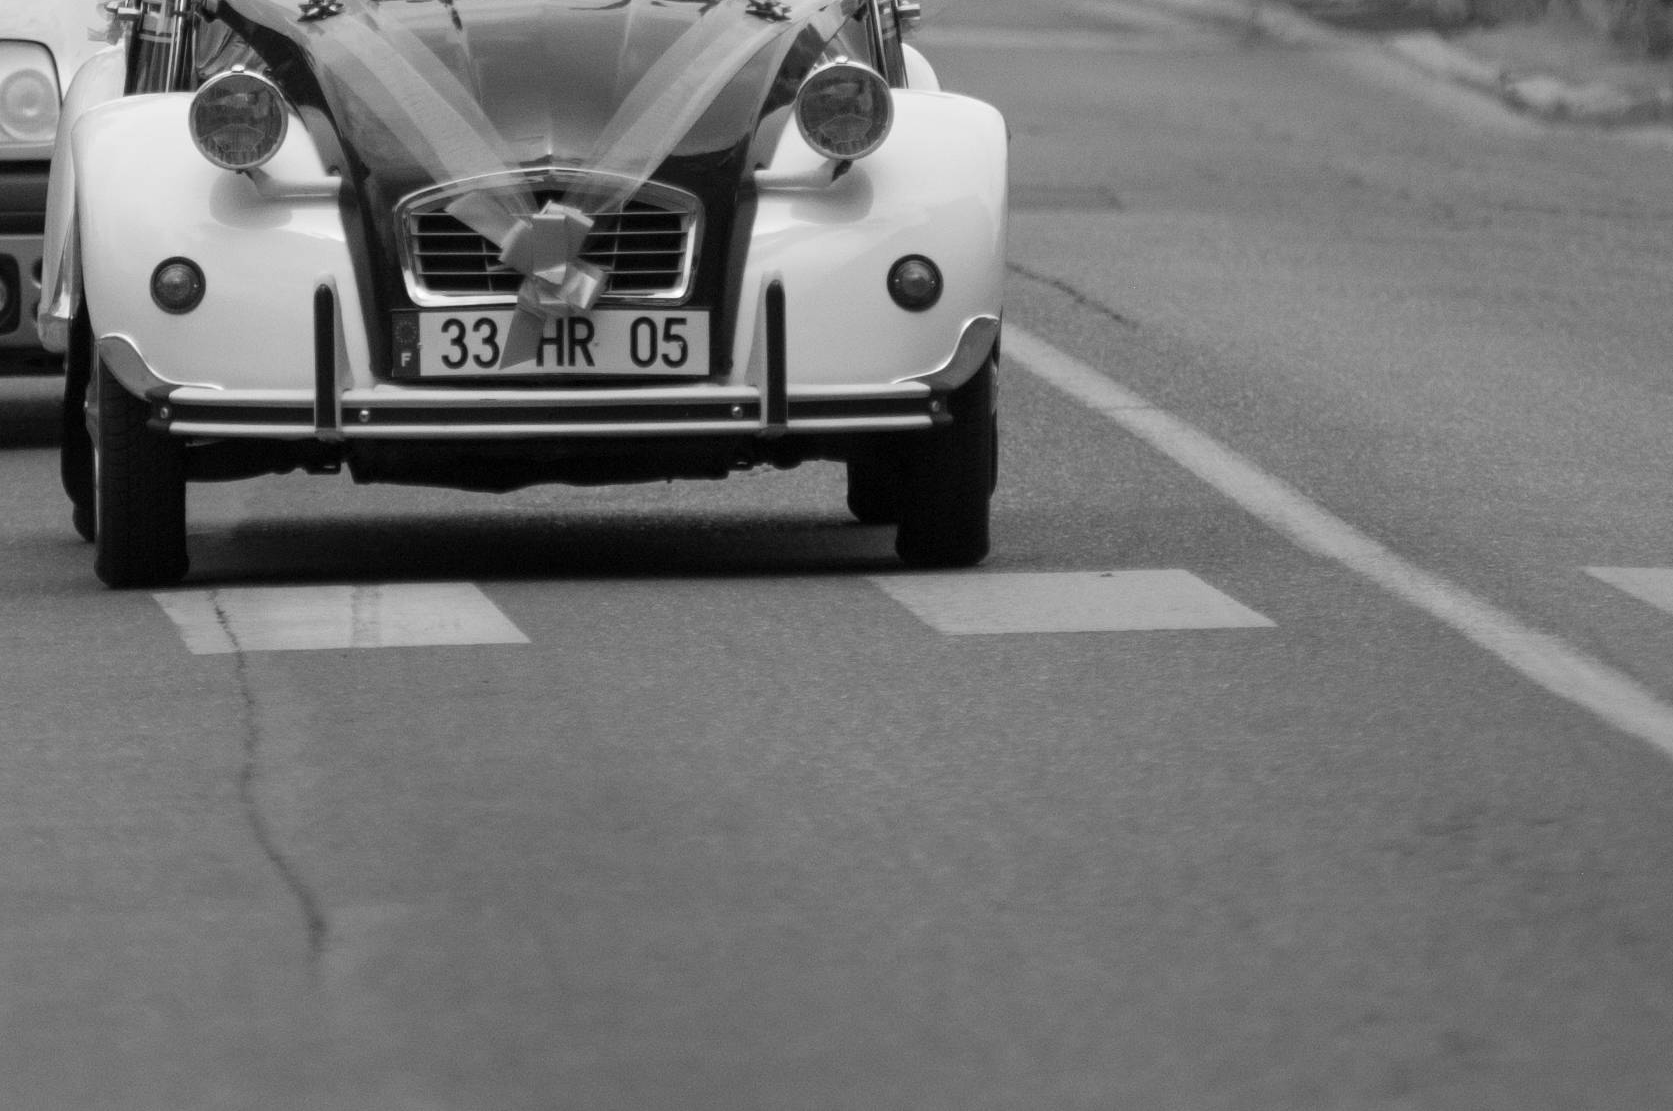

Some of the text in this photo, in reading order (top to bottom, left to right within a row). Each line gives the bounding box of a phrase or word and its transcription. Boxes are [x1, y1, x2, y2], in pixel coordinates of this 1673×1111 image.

[401, 352, 412, 367] F
[441, 316, 688, 369] 33 HR 05
